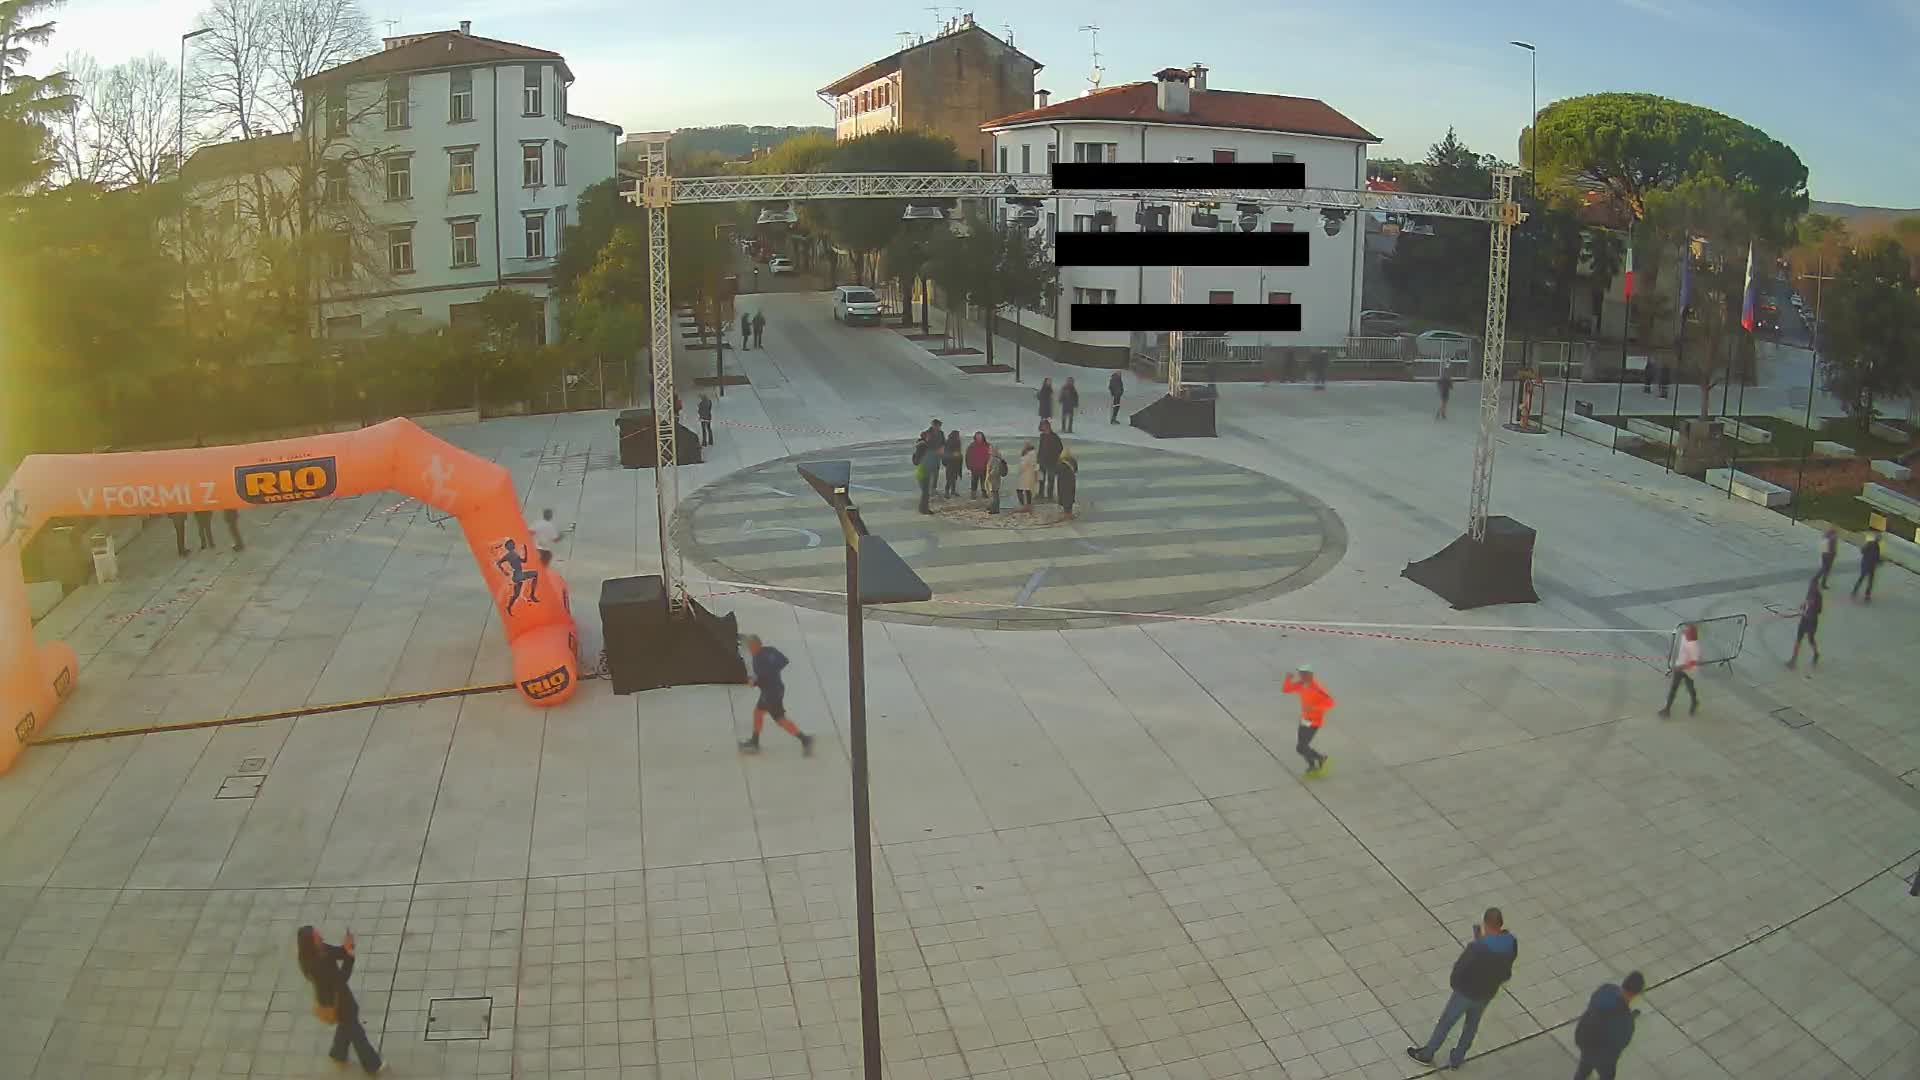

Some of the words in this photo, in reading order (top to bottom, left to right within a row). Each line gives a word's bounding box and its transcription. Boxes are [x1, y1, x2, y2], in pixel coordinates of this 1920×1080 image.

[77, 487, 94, 511] V
[103, 481, 192, 511] FORMI
[199, 481, 219, 504] Z
[245, 466, 327, 496] RIO
[527, 672, 565, 694] RIO
